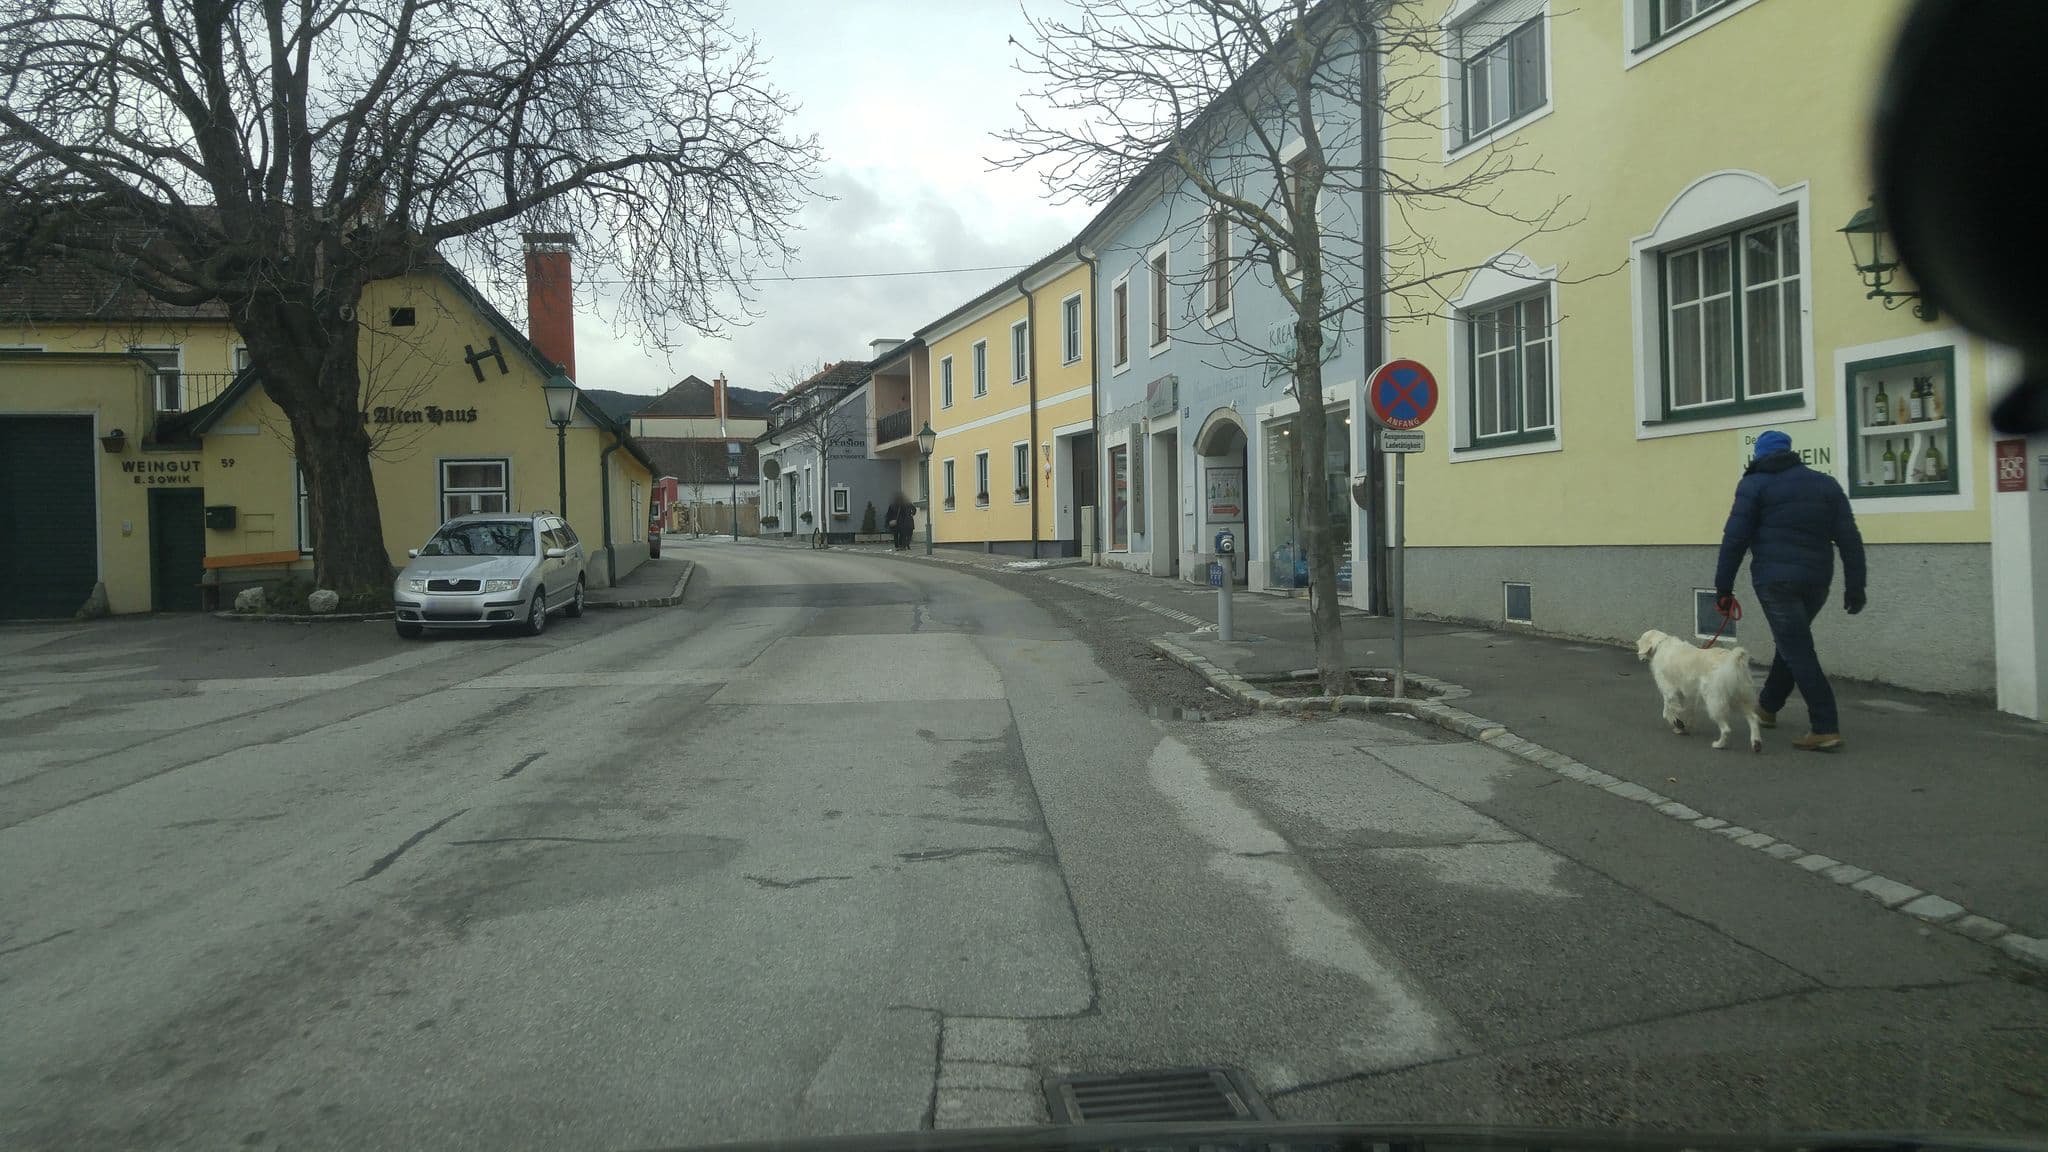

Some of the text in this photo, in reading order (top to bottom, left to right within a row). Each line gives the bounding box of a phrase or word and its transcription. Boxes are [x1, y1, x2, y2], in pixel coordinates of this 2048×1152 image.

[424, 405, 478, 425] Haus
[1386, 416, 1421, 428] ANFANG
[1745, 435, 1757, 446] De
[121, 460, 202, 473] WEINGUT
[221, 458, 236, 468] 59
